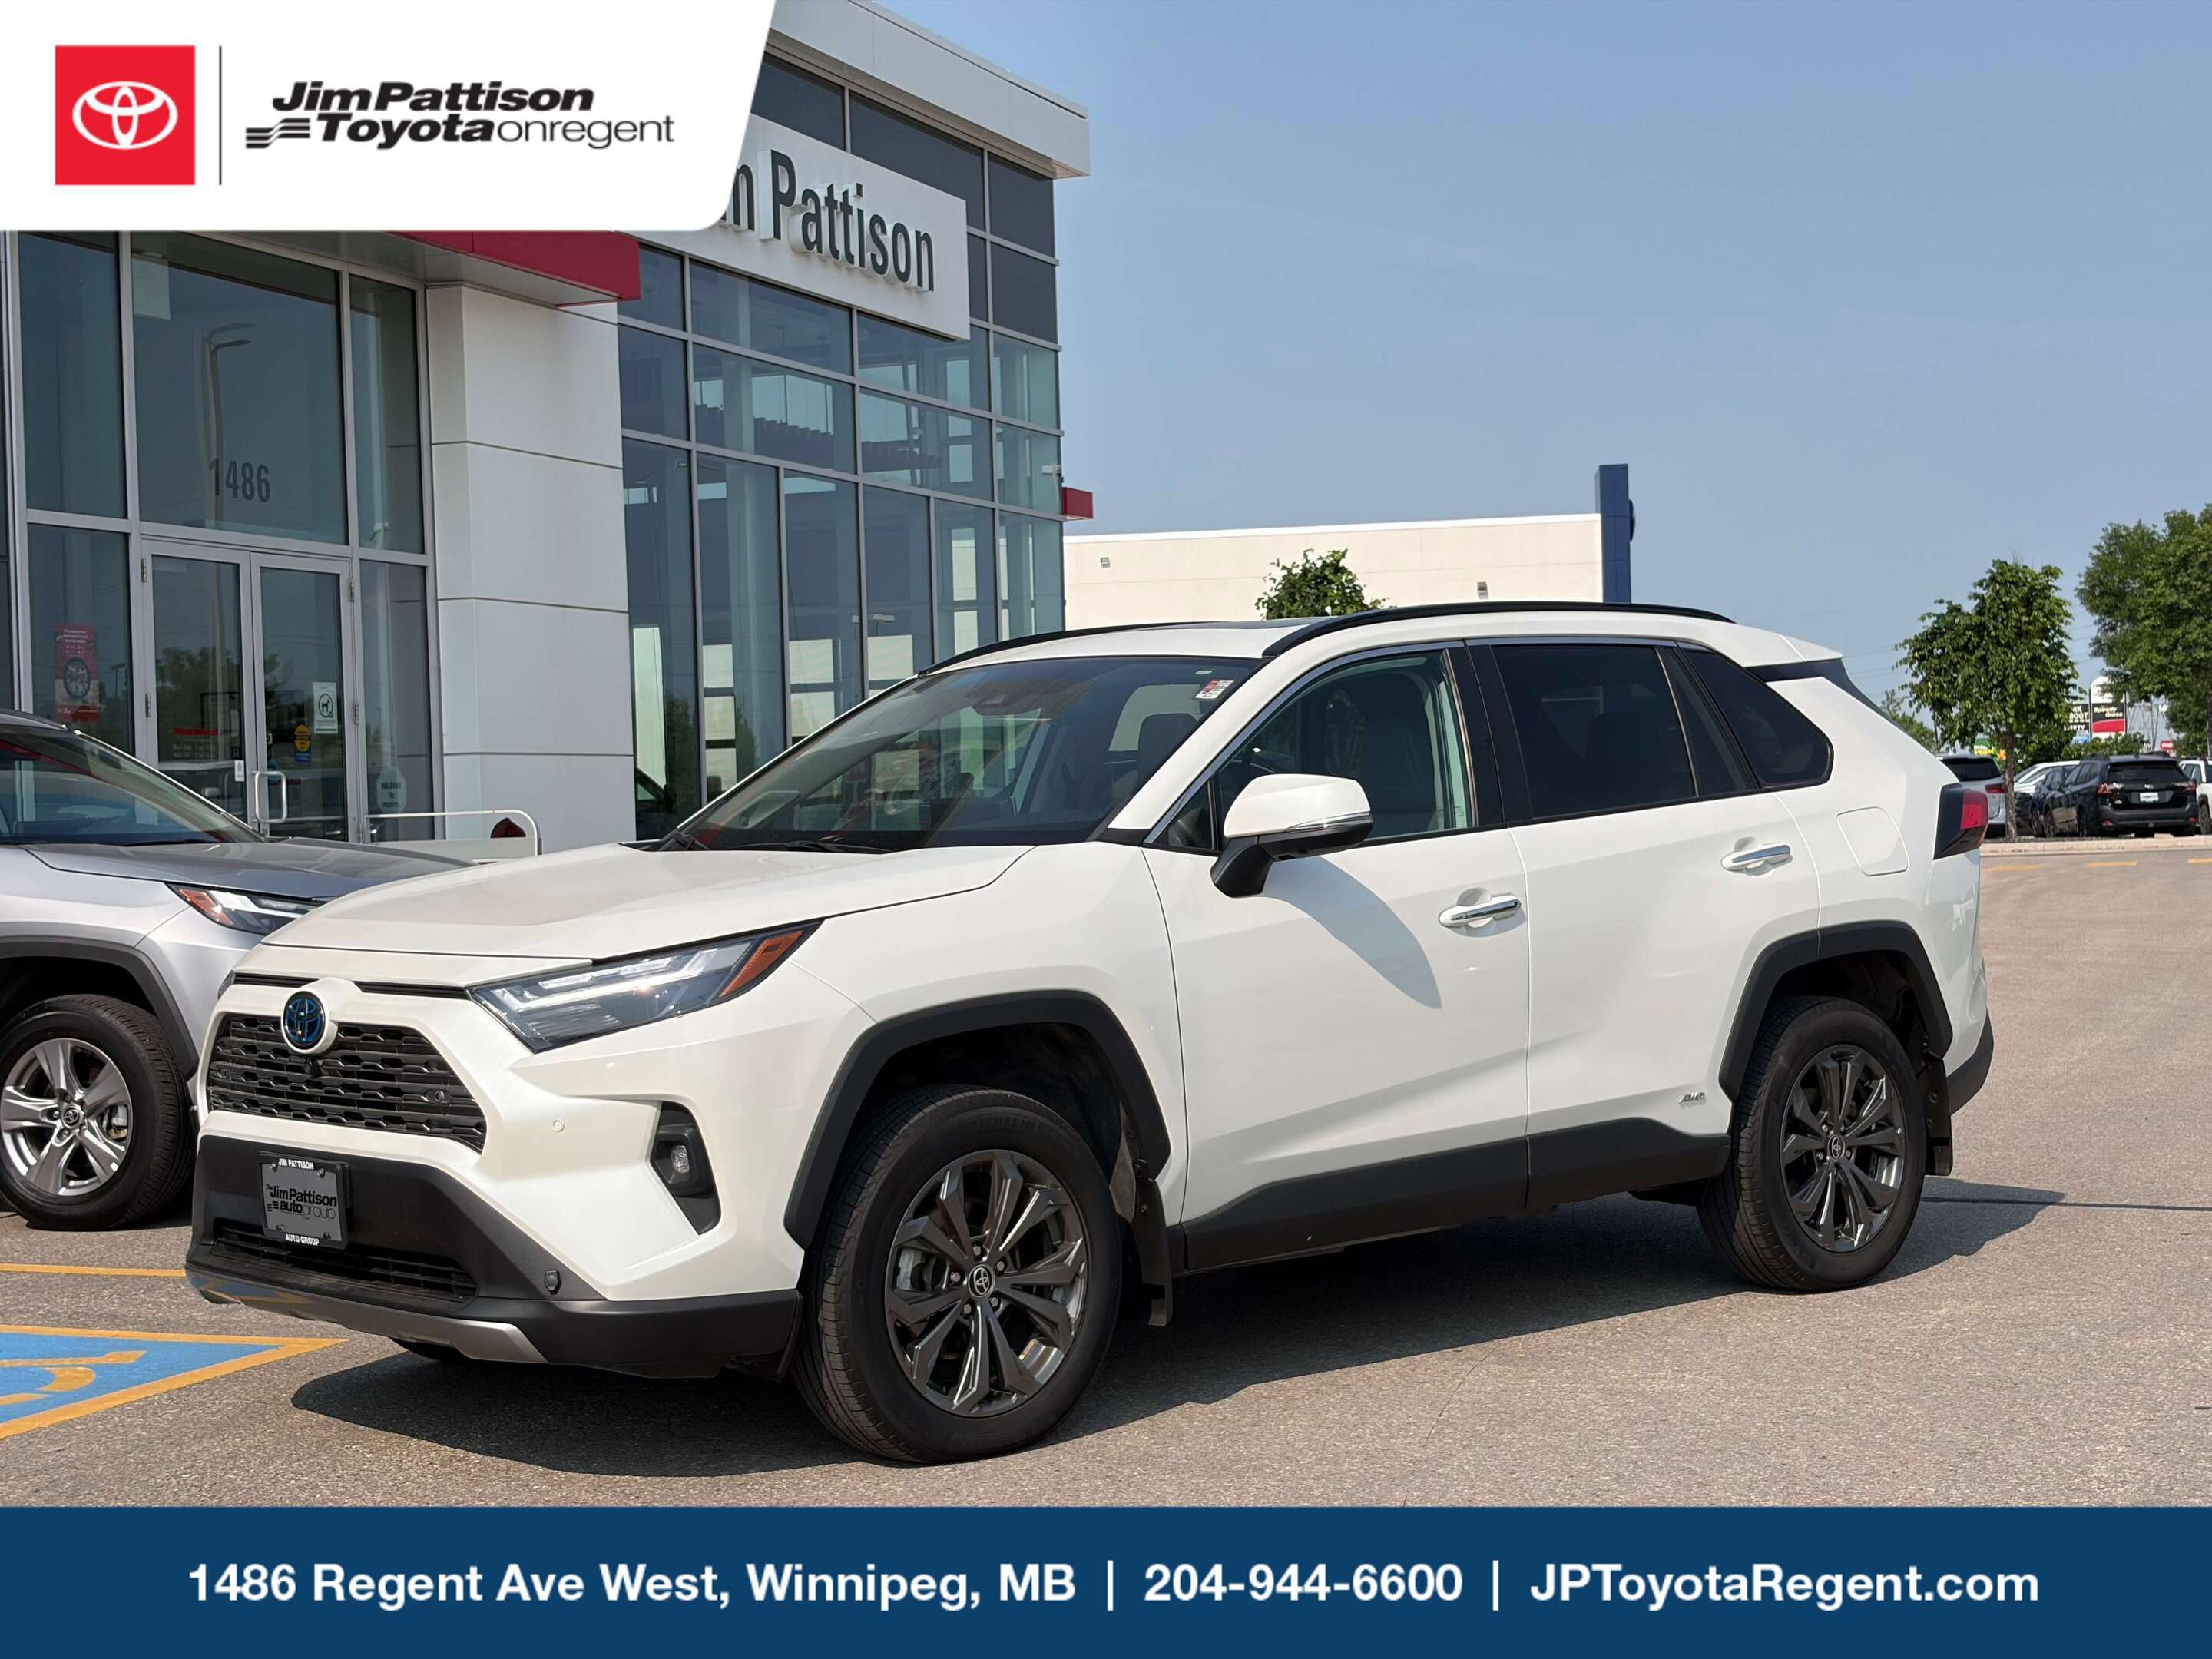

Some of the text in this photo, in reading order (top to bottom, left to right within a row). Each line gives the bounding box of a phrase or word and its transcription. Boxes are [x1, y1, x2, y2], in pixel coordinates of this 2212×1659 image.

[770, 149, 935, 292] Pattison
[209, 458, 271, 504] 1486
[278, 1157, 314, 1170] JIM PATTISON
[285, 1233, 320, 1247] AUTO GROUP
